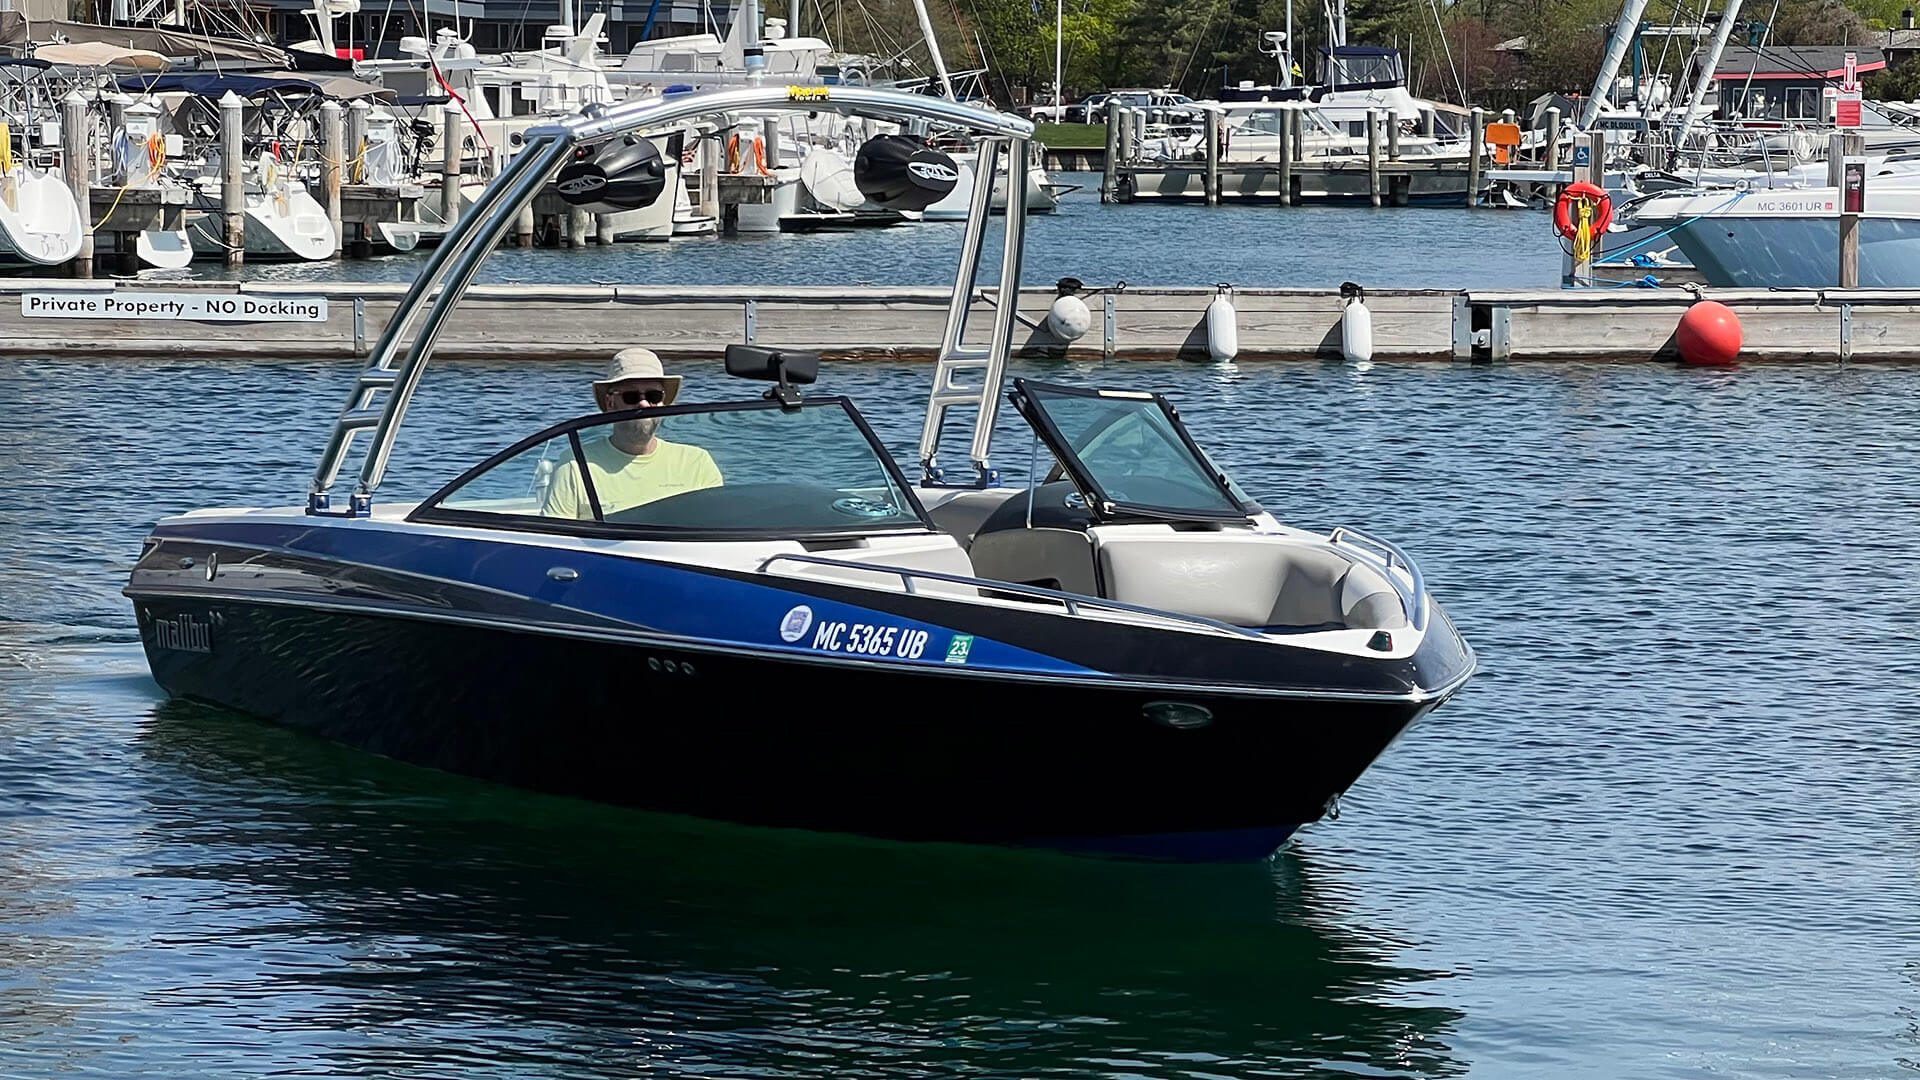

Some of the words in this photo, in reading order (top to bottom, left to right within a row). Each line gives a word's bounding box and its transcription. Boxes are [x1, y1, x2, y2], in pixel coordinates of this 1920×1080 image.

[1757, 202, 1776, 211] MC
[1779, 202, 1803, 211] 3601
[1805, 202, 1822, 211] UR
[30, 297, 97, 313] Private
[104, 298, 185, 316] Property
[206, 300, 237, 314] NO
[244, 301, 320, 318] Docking
[156, 613, 210, 653] malibu
[812, 621, 847, 651] MC
[846, 623, 898, 656] 5365
[896, 629, 929, 659] UB
